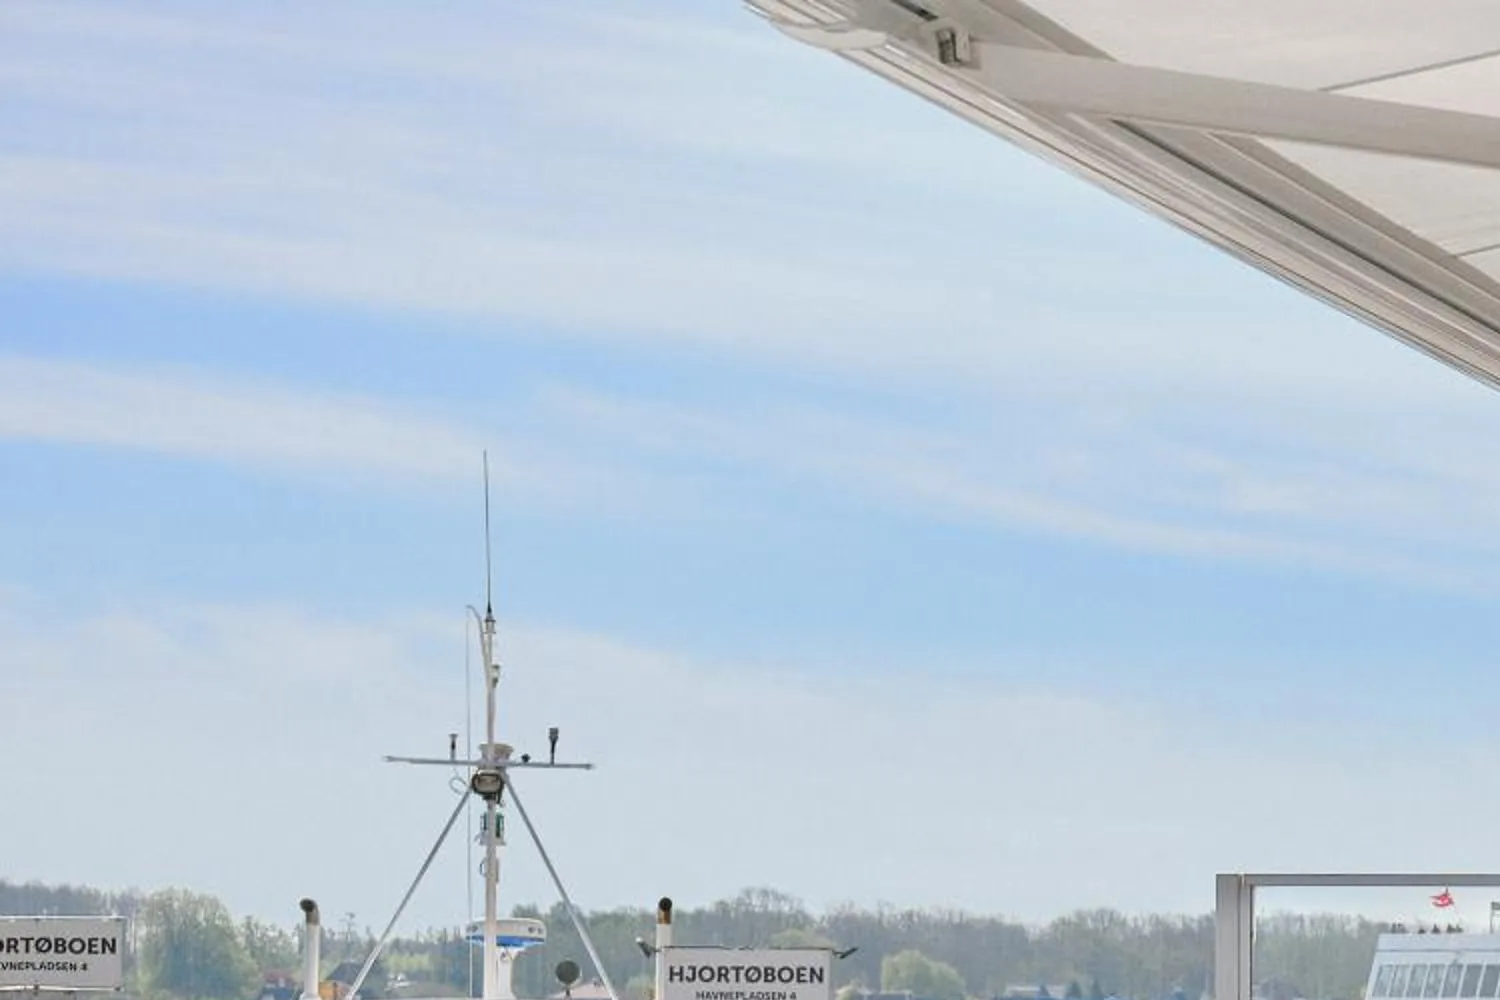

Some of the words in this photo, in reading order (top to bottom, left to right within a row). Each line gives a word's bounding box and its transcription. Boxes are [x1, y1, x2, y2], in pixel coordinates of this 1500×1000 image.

[0, 937, 117, 955] RTØBOEN
[668, 965, 825, 983] HJORTØBOEN
[695, 990, 787, 1000] HAVNEPLADSEN
